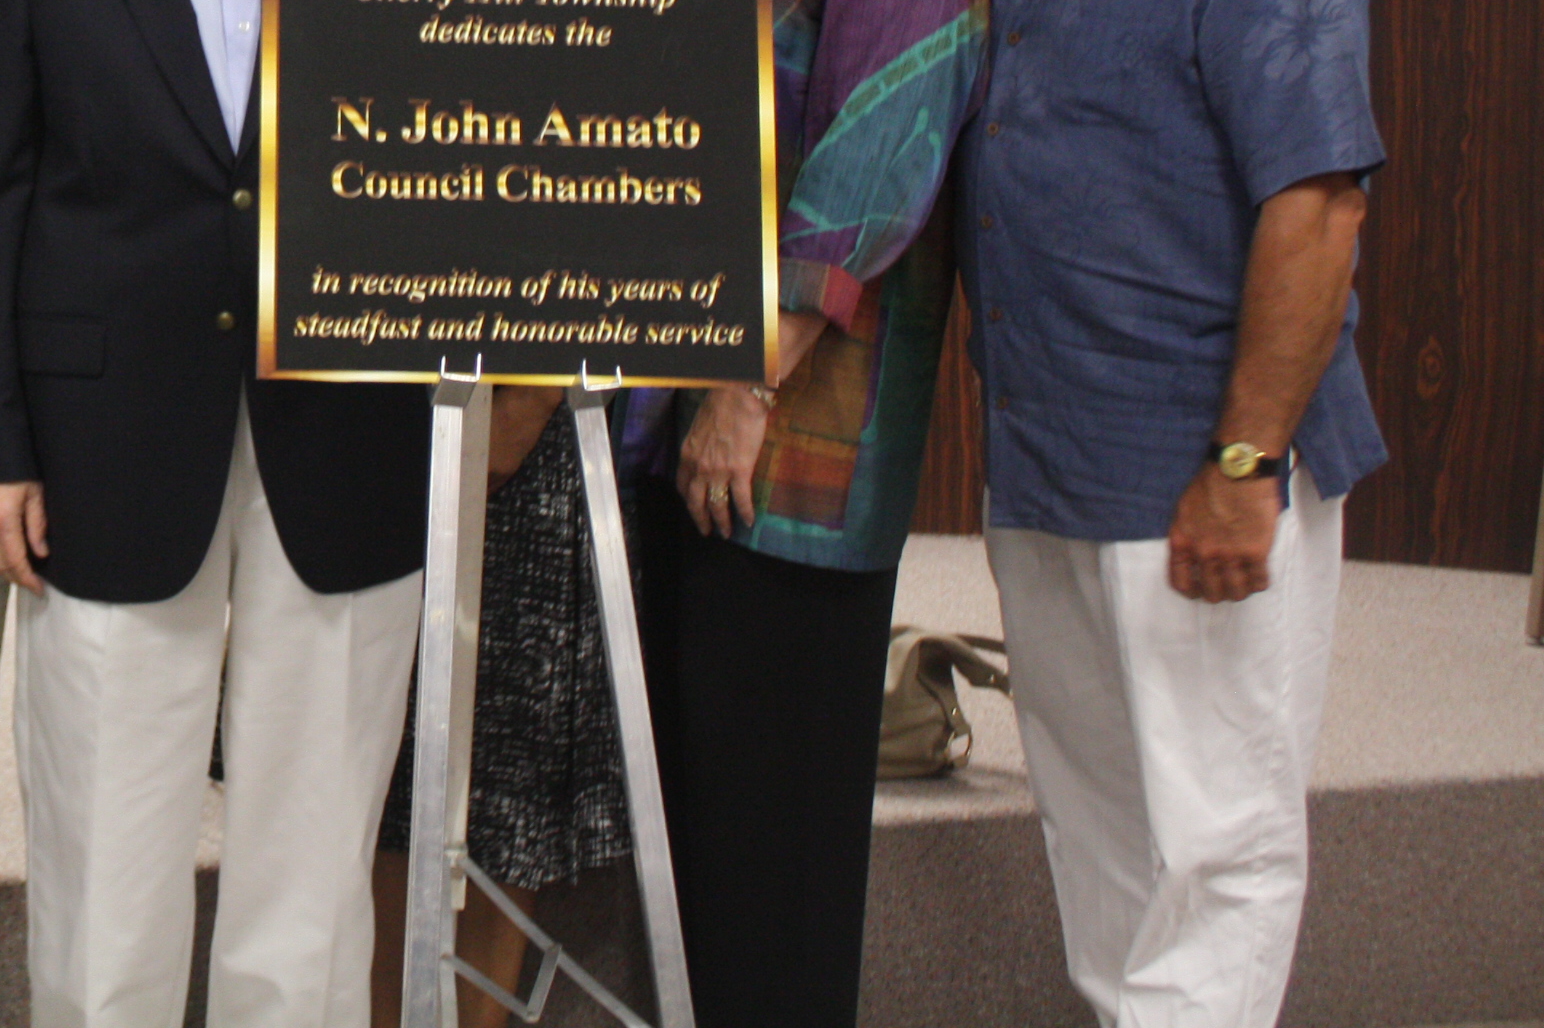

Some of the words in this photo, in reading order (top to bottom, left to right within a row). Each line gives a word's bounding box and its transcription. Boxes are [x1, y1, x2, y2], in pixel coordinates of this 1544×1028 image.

[419, 14, 556, 46] dedicates
[565, 17, 613, 47] the
[331, 96, 387, 143] N.
[401, 98, 523, 146] John
[532, 103, 702, 150] Amato
[331, 160, 485, 201] Council
[496, 164, 703, 206] Chambers
[311, 265, 341, 295] in
[349, 268, 513, 304] recognition
[520, 269, 557, 305] of
[558, 270, 601, 300] his
[603, 279, 684, 307] years
[689, 272, 726, 308] of
[293, 309, 423, 346] steadfast
[427, 312, 486, 342] and
[490, 312, 639, 345] honorable
[644, 316, 745, 347] service
